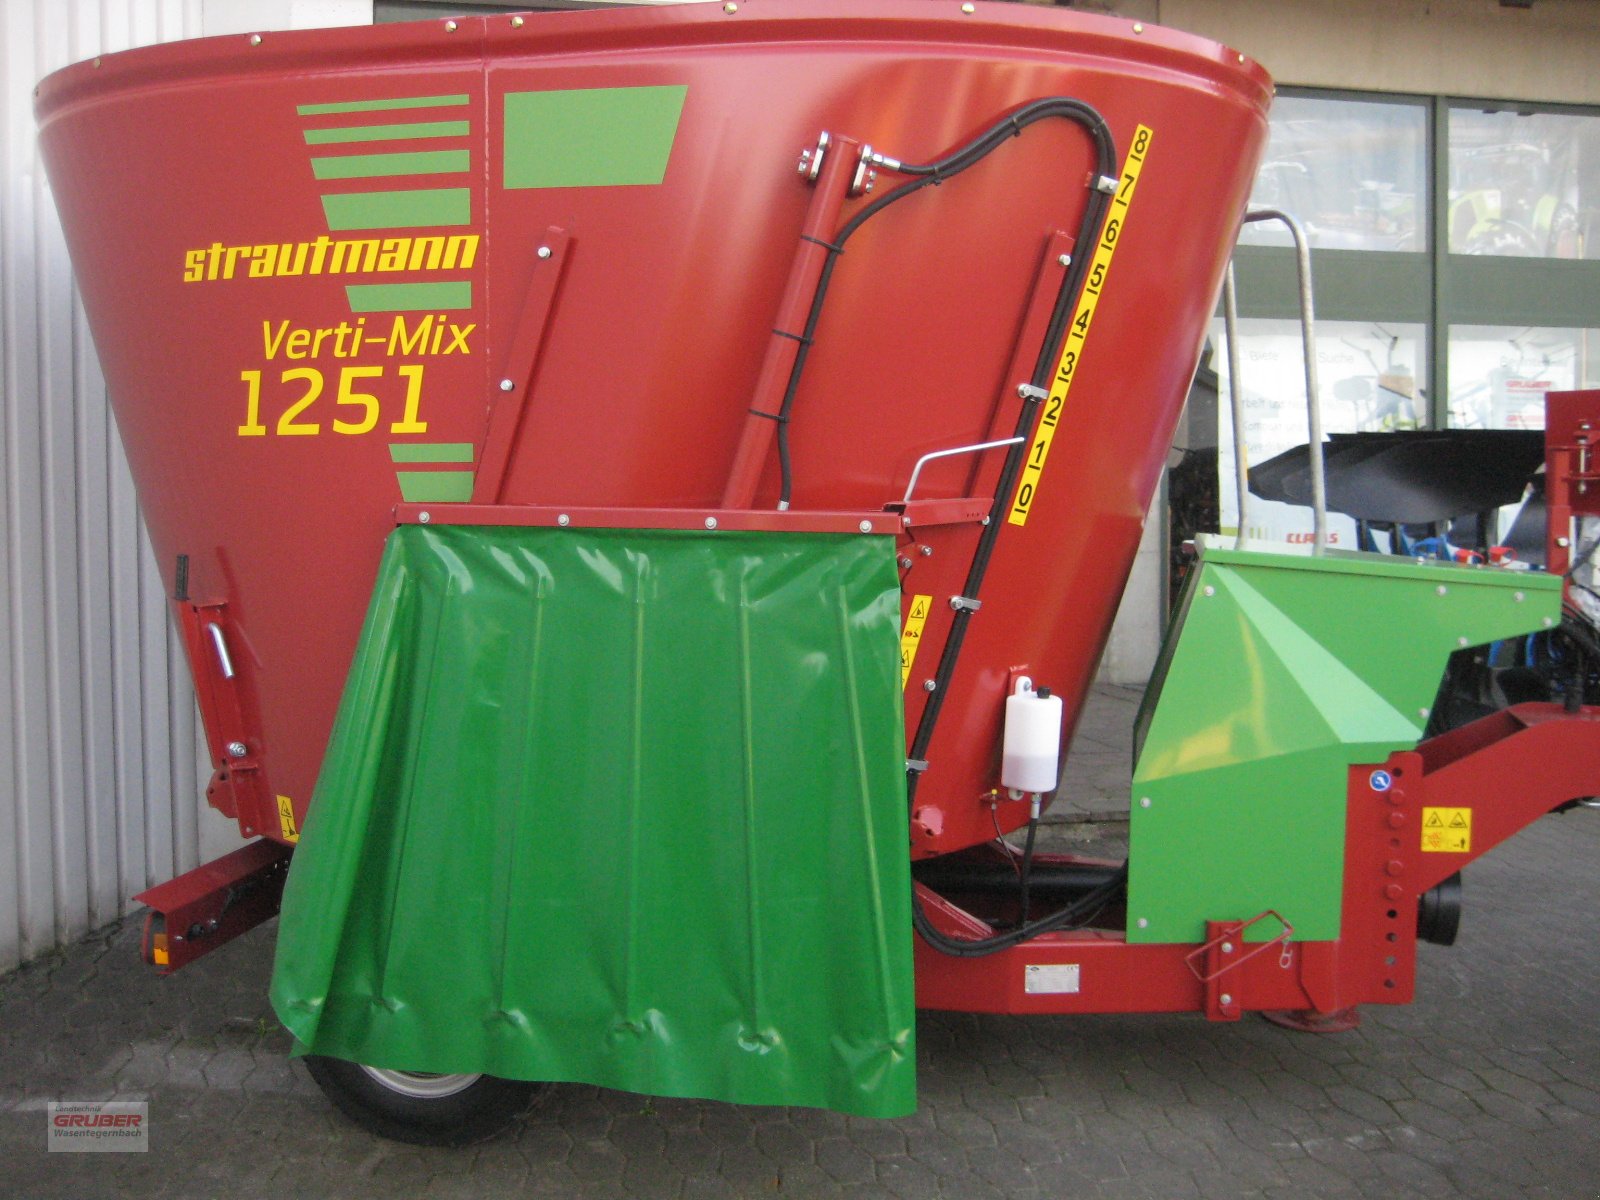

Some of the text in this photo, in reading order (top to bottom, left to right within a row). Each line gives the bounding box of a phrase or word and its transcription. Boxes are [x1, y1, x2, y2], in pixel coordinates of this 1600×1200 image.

[1133, 129, 1149, 154] 8
[1119, 174, 1135, 198] 7
[1105, 219, 1120, 243] 6
[184, 235, 480, 282] strautmann
[1089, 264, 1105, 288] 5
[1075, 309, 1090, 332] 4
[263, 315, 476, 360] Verti-Mix
[1060, 351, 1076, 376] 3
[238, 365, 428, 437] 1251
[1045, 396, 1062, 421] 2
[1034, 440, 1046, 464] 1
[1018, 483, 1033, 507] 0
[1286, 533, 1338, 544] CLAS
